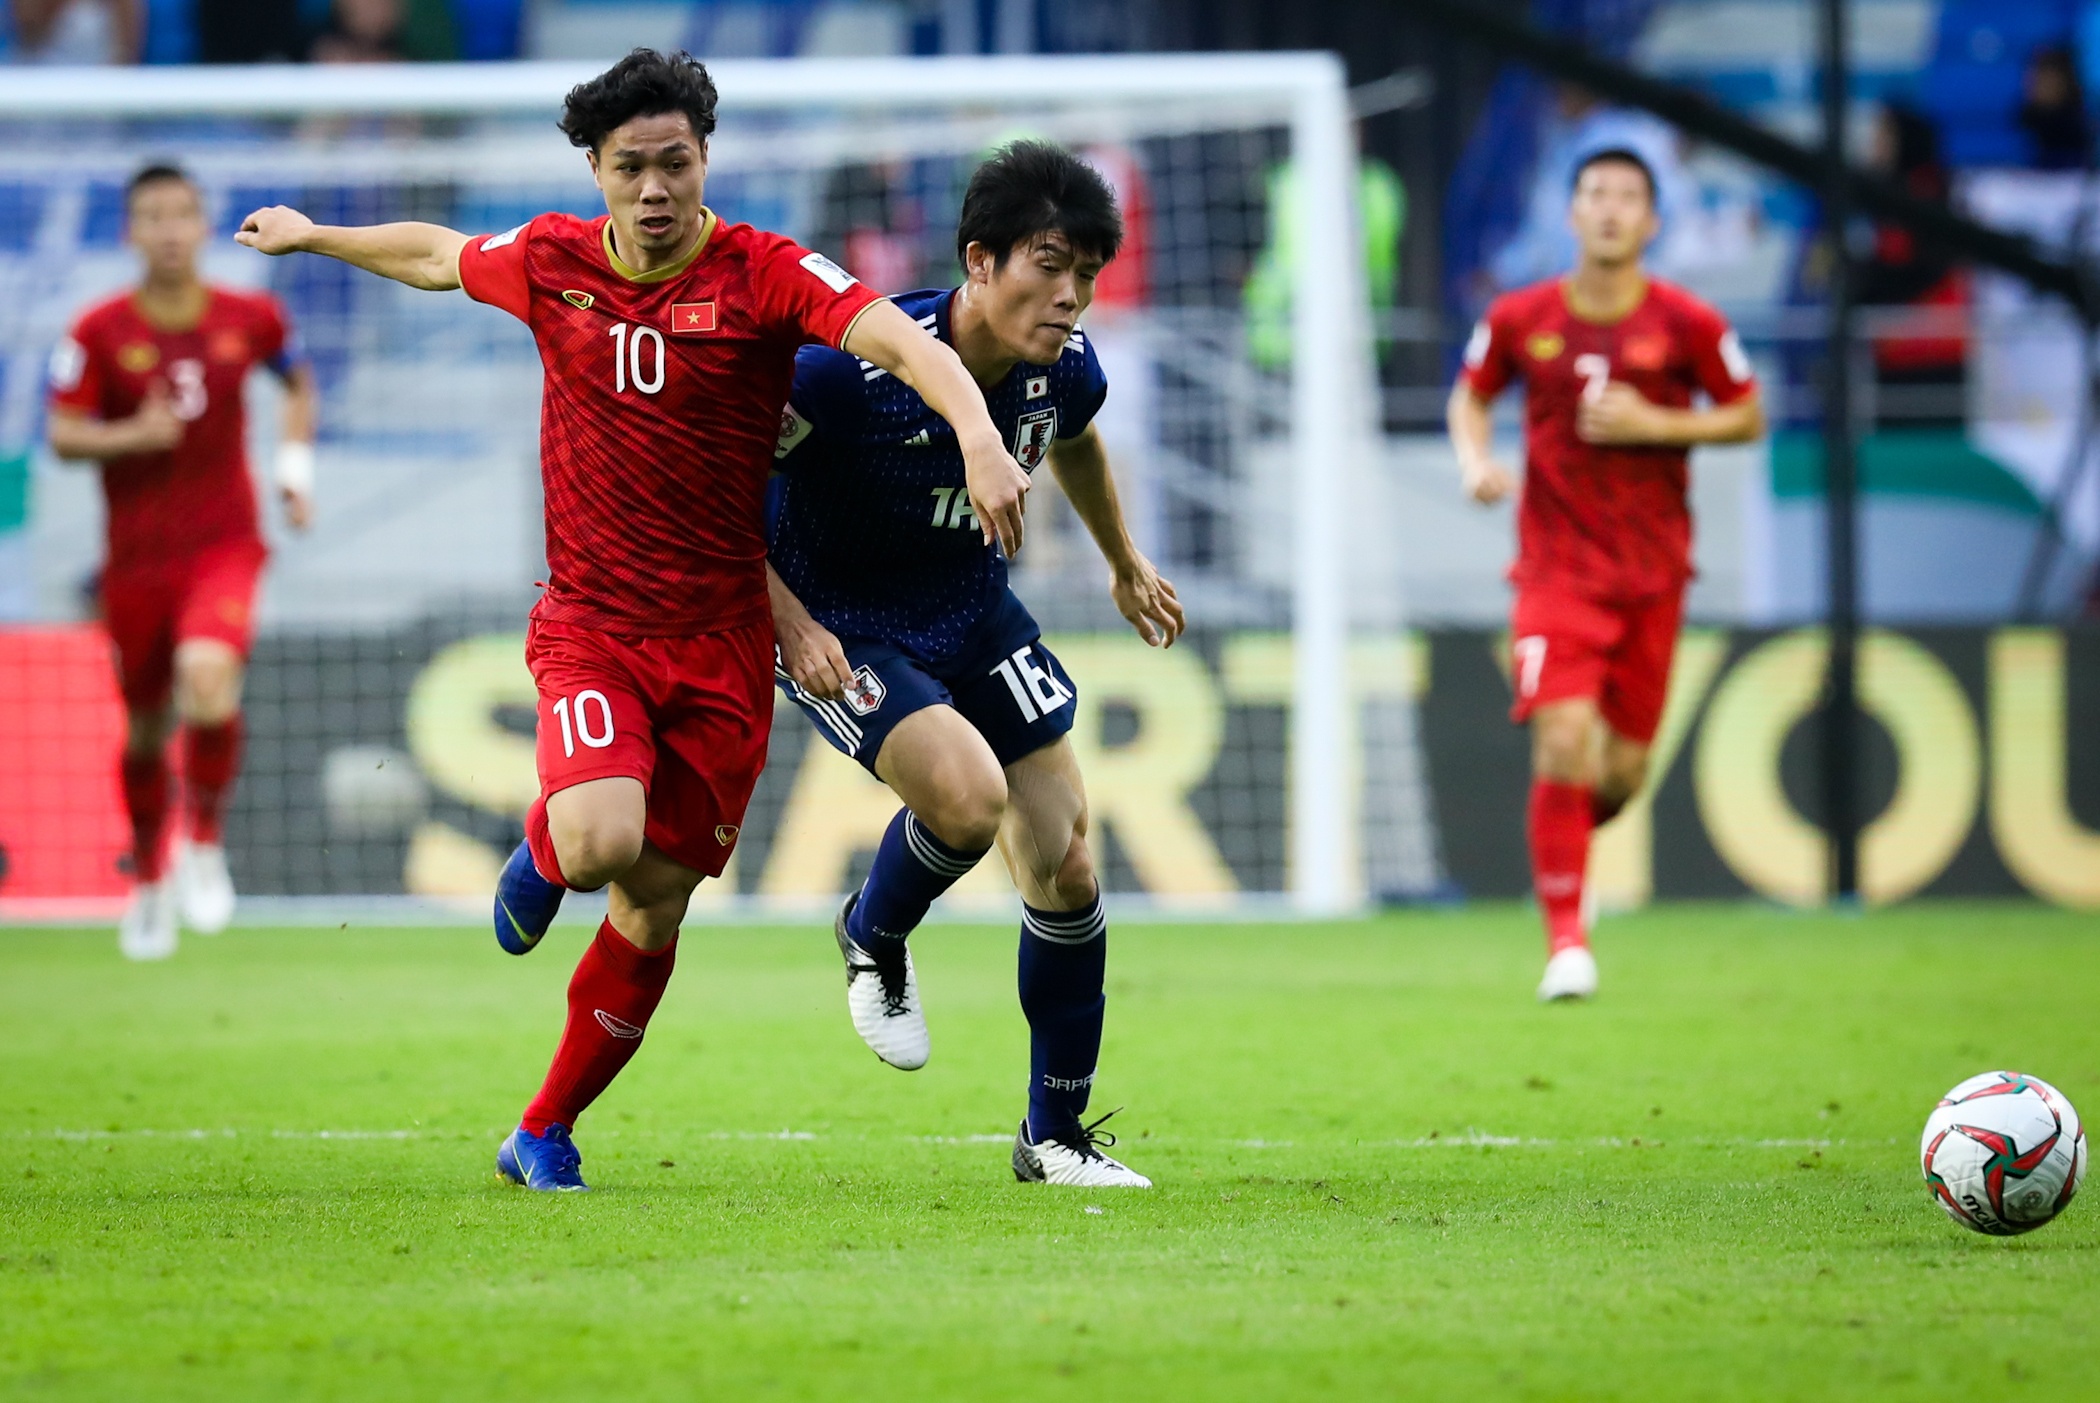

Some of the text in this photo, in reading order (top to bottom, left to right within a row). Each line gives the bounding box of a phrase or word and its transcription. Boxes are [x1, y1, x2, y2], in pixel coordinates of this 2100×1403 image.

[166, 356, 208, 422] 3
[608, 322, 666, 395] 10
[1574, 353, 1610, 403] 7
[1028, 412, 1049, 422] JAPAN
[989, 645, 1074, 724] 16
[1514, 634, 1548, 699] 7
[552, 689, 616, 758] 10
[406, 632, 1430, 903] SRT
[1043, 1068, 1098, 1092] JAPA
